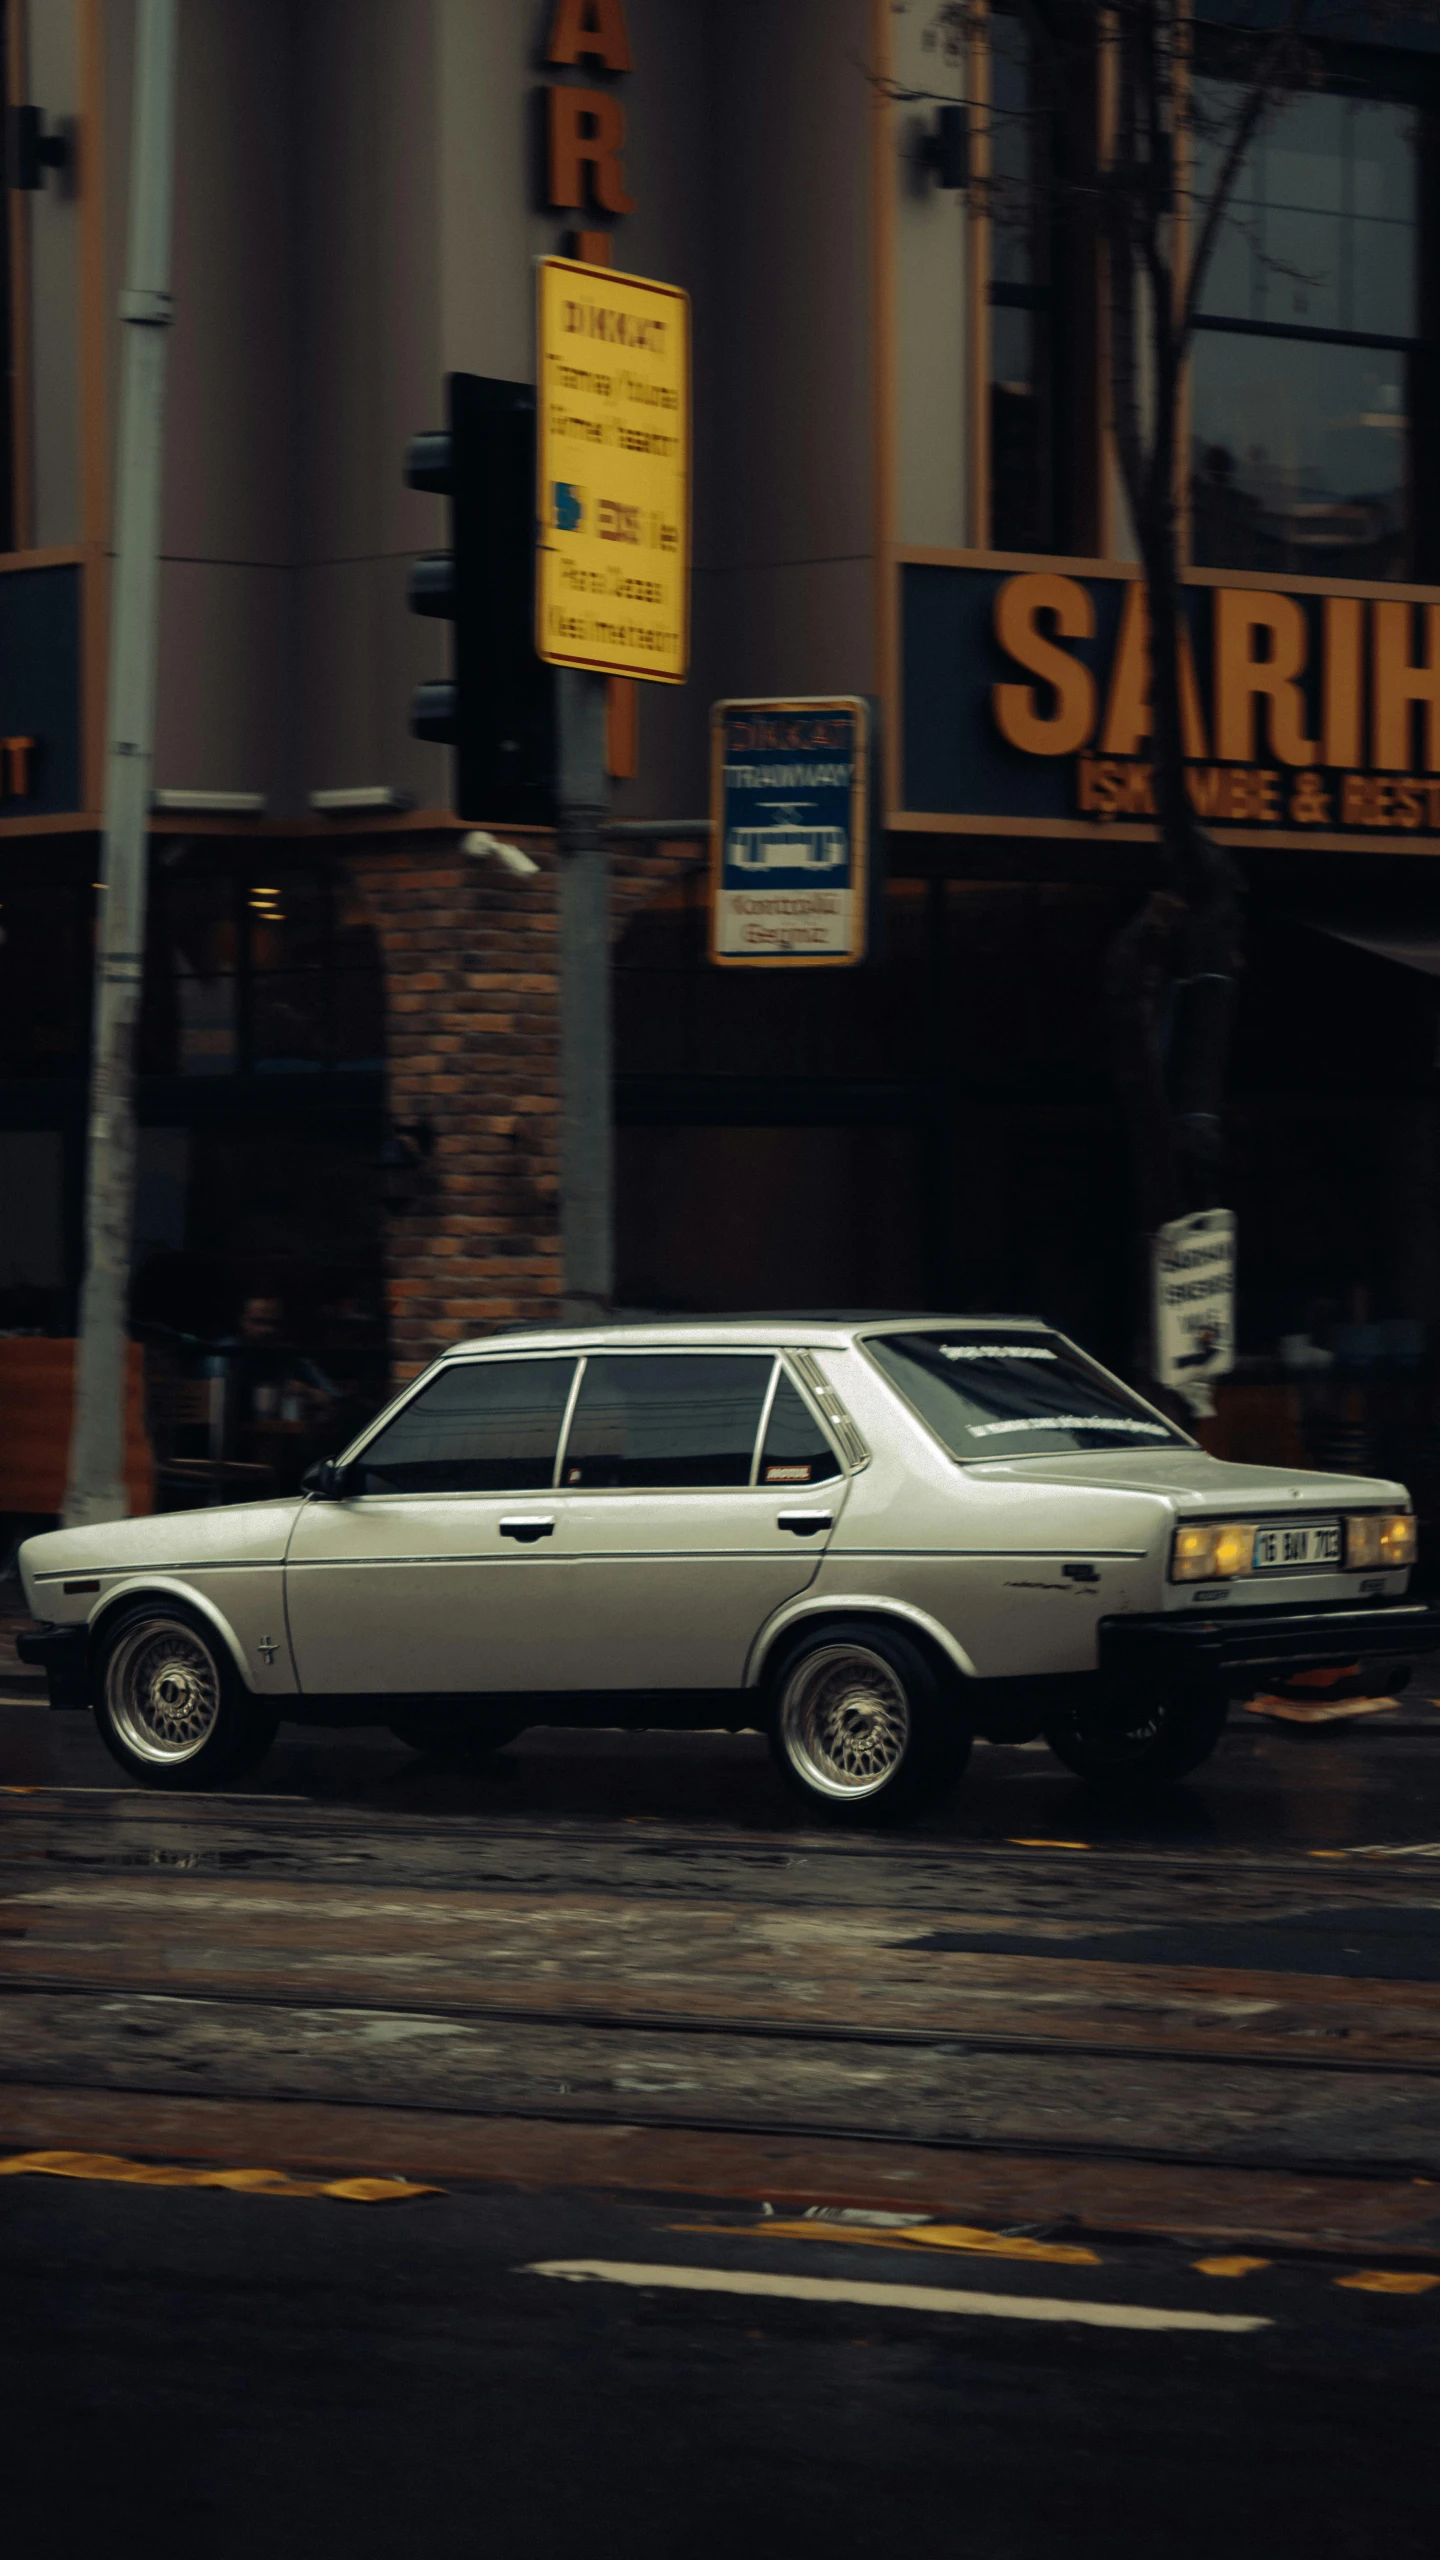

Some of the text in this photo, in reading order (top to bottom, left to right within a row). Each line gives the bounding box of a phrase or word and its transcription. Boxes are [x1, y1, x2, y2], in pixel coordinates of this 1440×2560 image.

[563, 297, 668, 354] DİKKAT
[597, 497, 641, 546] EDS
[992, 573, 1440, 772] SARIH
[1077, 748, 1281, 823] İŞKMBE
[1290, 770, 1332, 824] &
